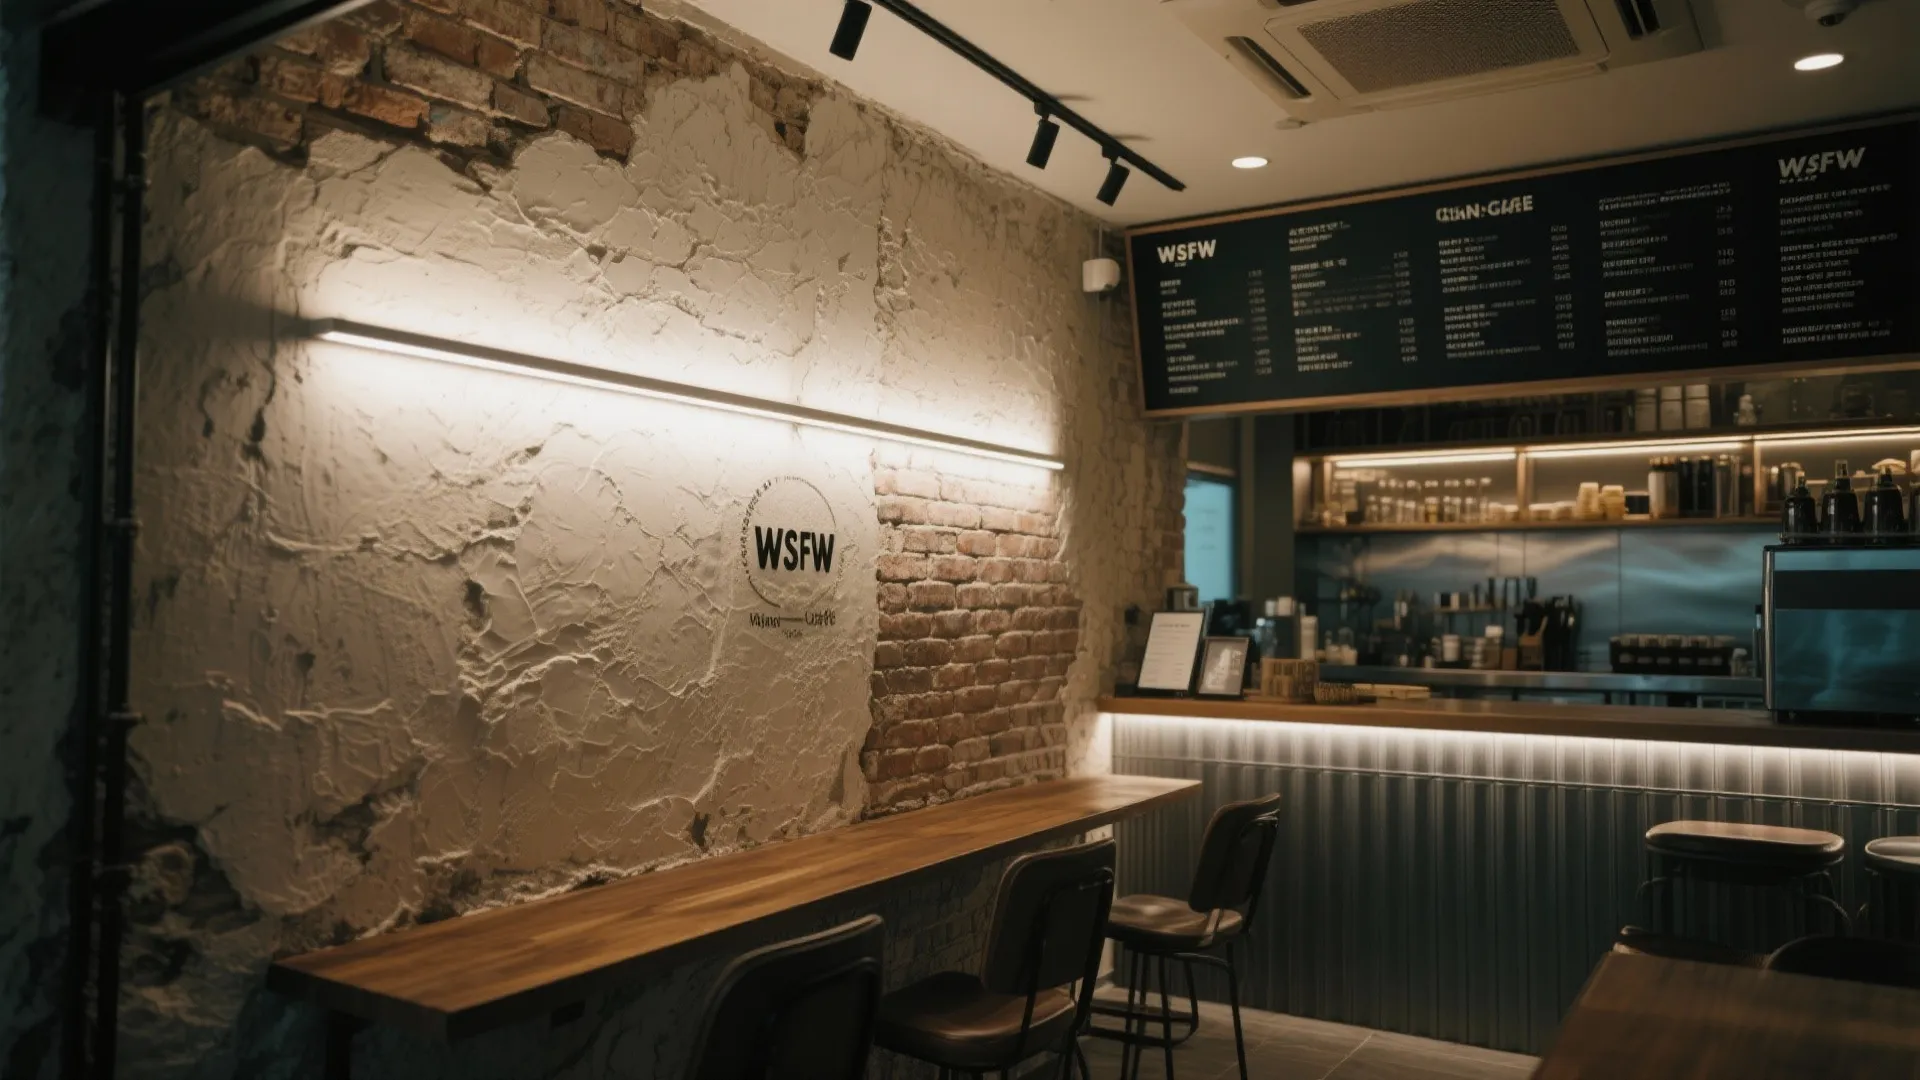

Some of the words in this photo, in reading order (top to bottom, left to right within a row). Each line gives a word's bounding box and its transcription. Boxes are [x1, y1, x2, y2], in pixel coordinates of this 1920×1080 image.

[1778, 147, 1865, 177] WSFW
[1157, 239, 1216, 263] WSFW
[755, 526, 835, 573] WSFW
